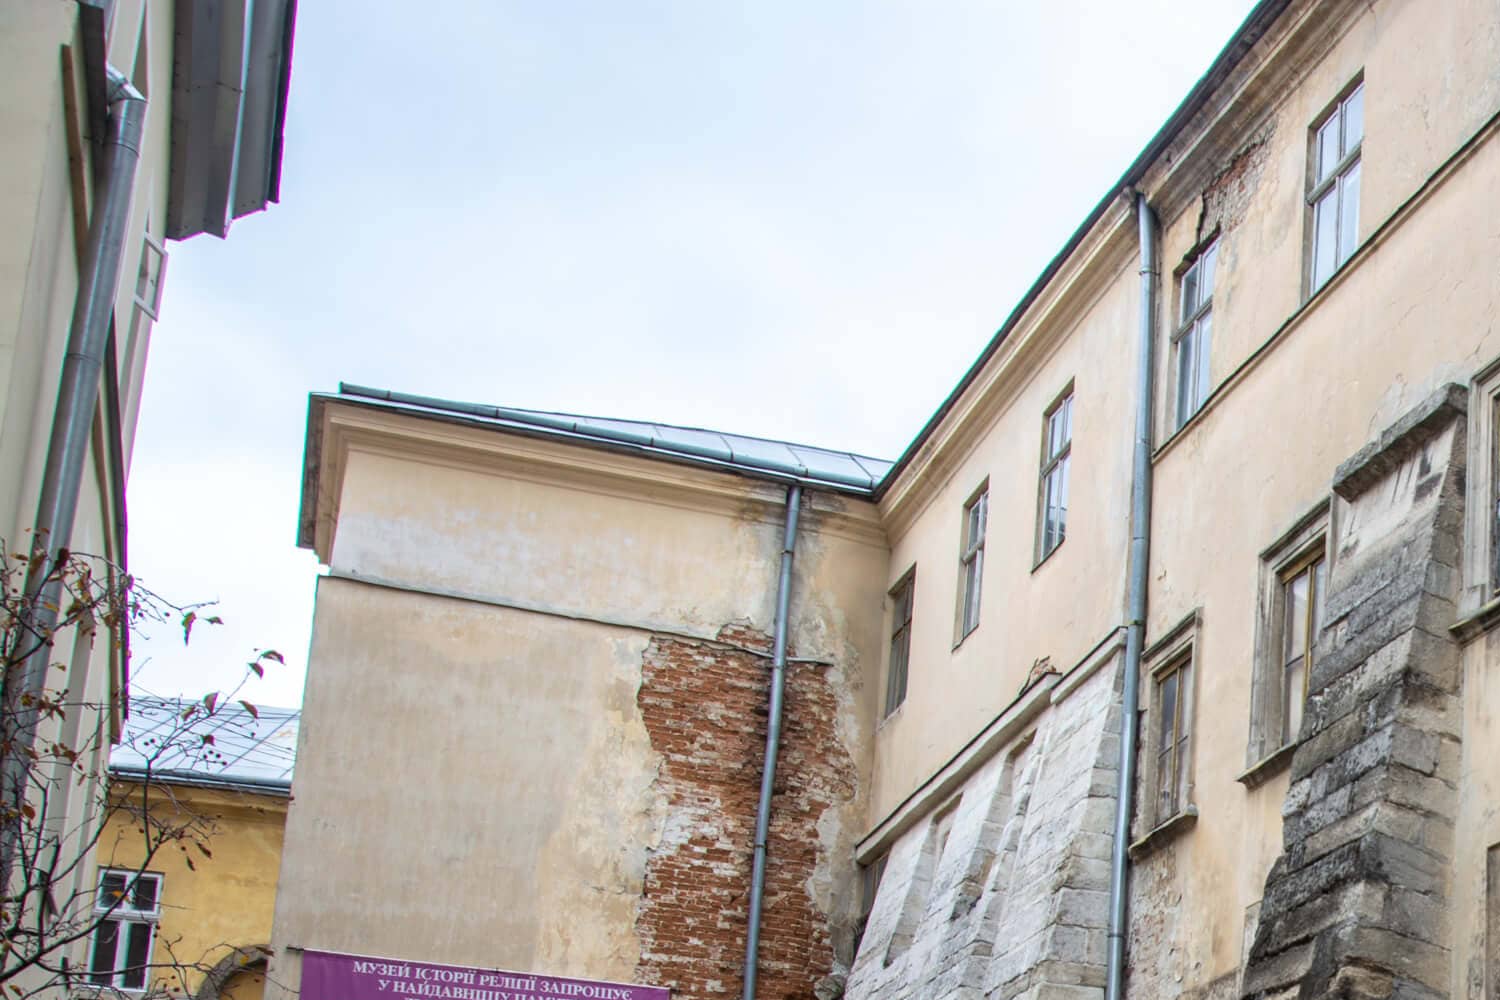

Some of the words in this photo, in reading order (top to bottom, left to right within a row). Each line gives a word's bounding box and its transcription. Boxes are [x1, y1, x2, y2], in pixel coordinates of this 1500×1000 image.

[352, 960, 411, 979] МУЗЕЙ
[415, 967, 477, 985] ІСТОРІЇ
[479, 974, 537, 991] РЕЛІГІЇ
[540, 980, 633, 1000] ЗАПРОШУЄ
[377, 979, 390, 991] У
